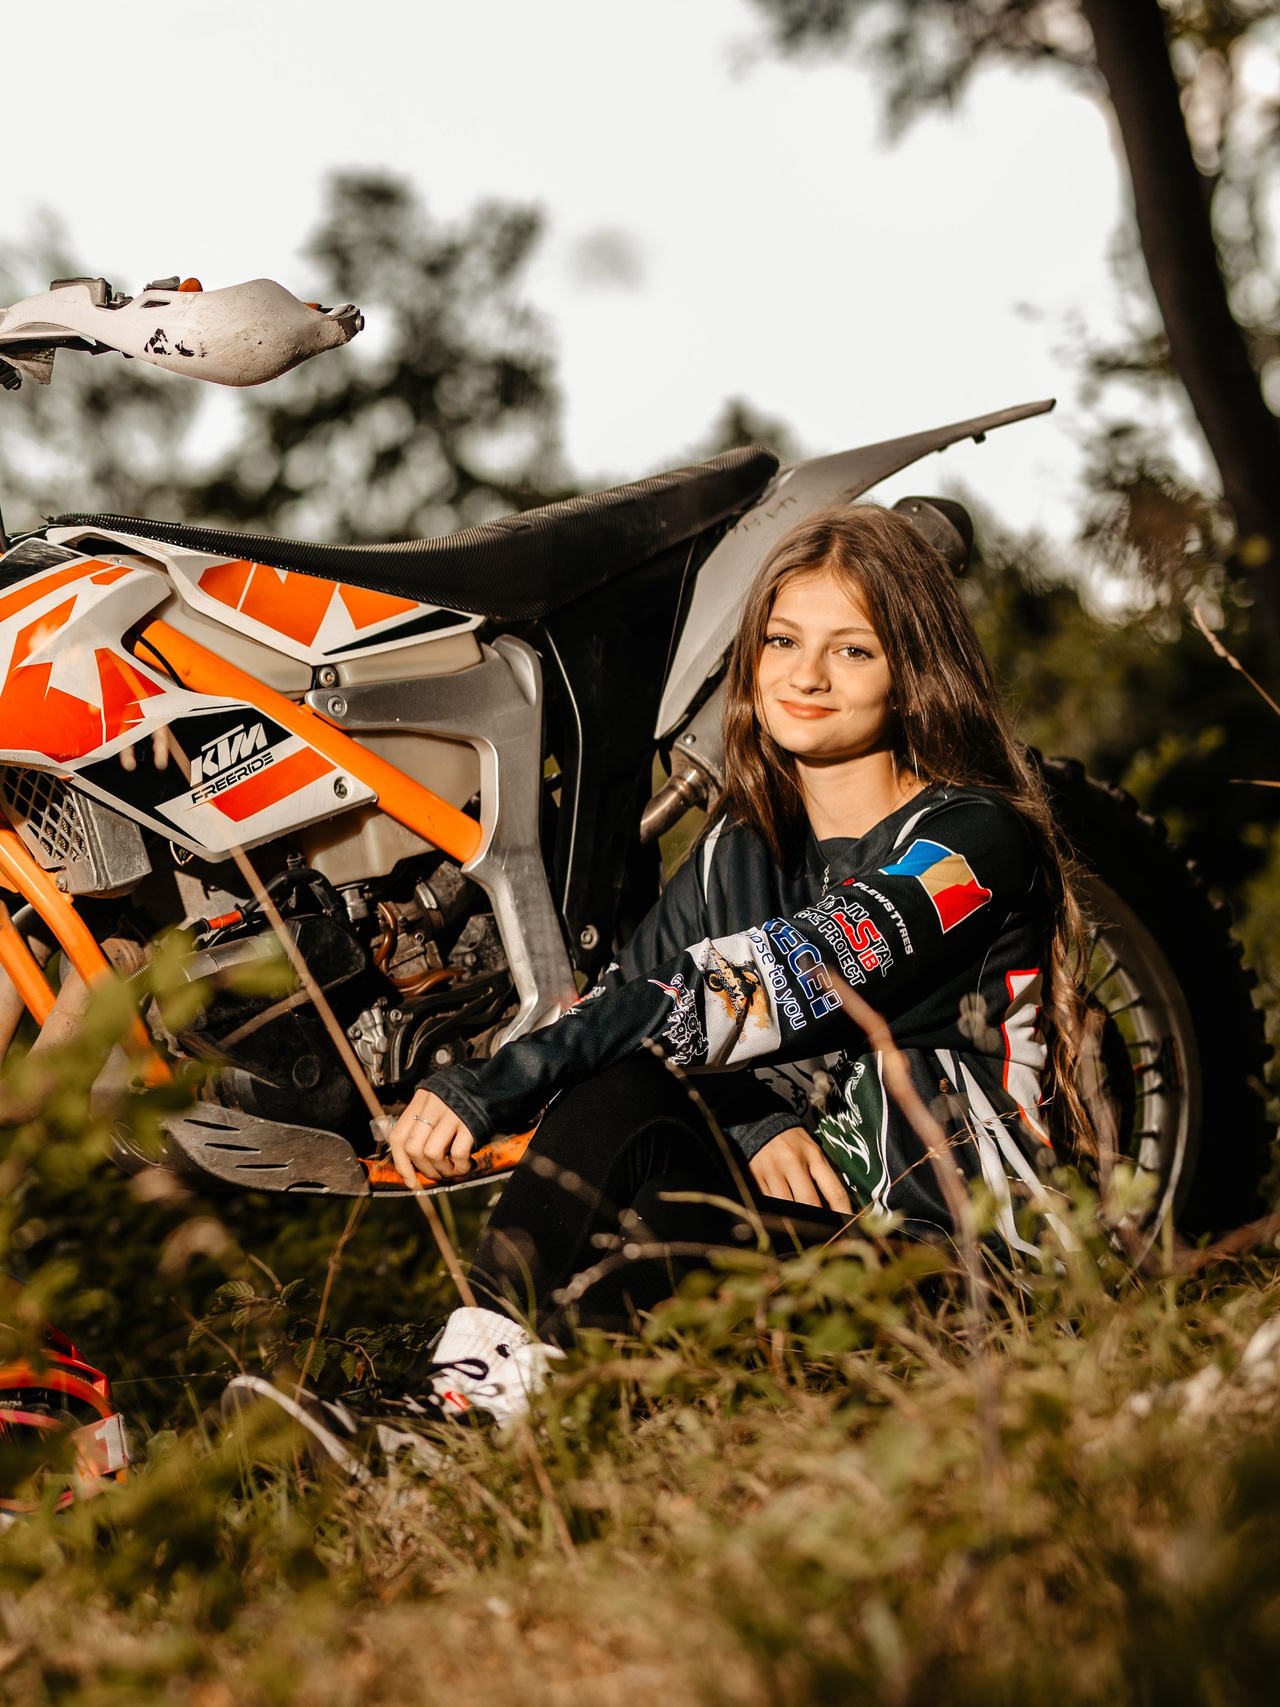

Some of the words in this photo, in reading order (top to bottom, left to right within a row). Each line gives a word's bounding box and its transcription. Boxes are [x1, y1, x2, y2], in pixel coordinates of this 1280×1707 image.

[190, 722, 268, 787] KTM
[192, 752, 274, 805] FREERIDE
[852, 881, 896, 913] PLEWS
[890, 910, 915, 956] TYRES
[769, 964, 788, 989] to
[818, 920, 867, 986] PROIECT
[773, 989, 808, 1031] you
